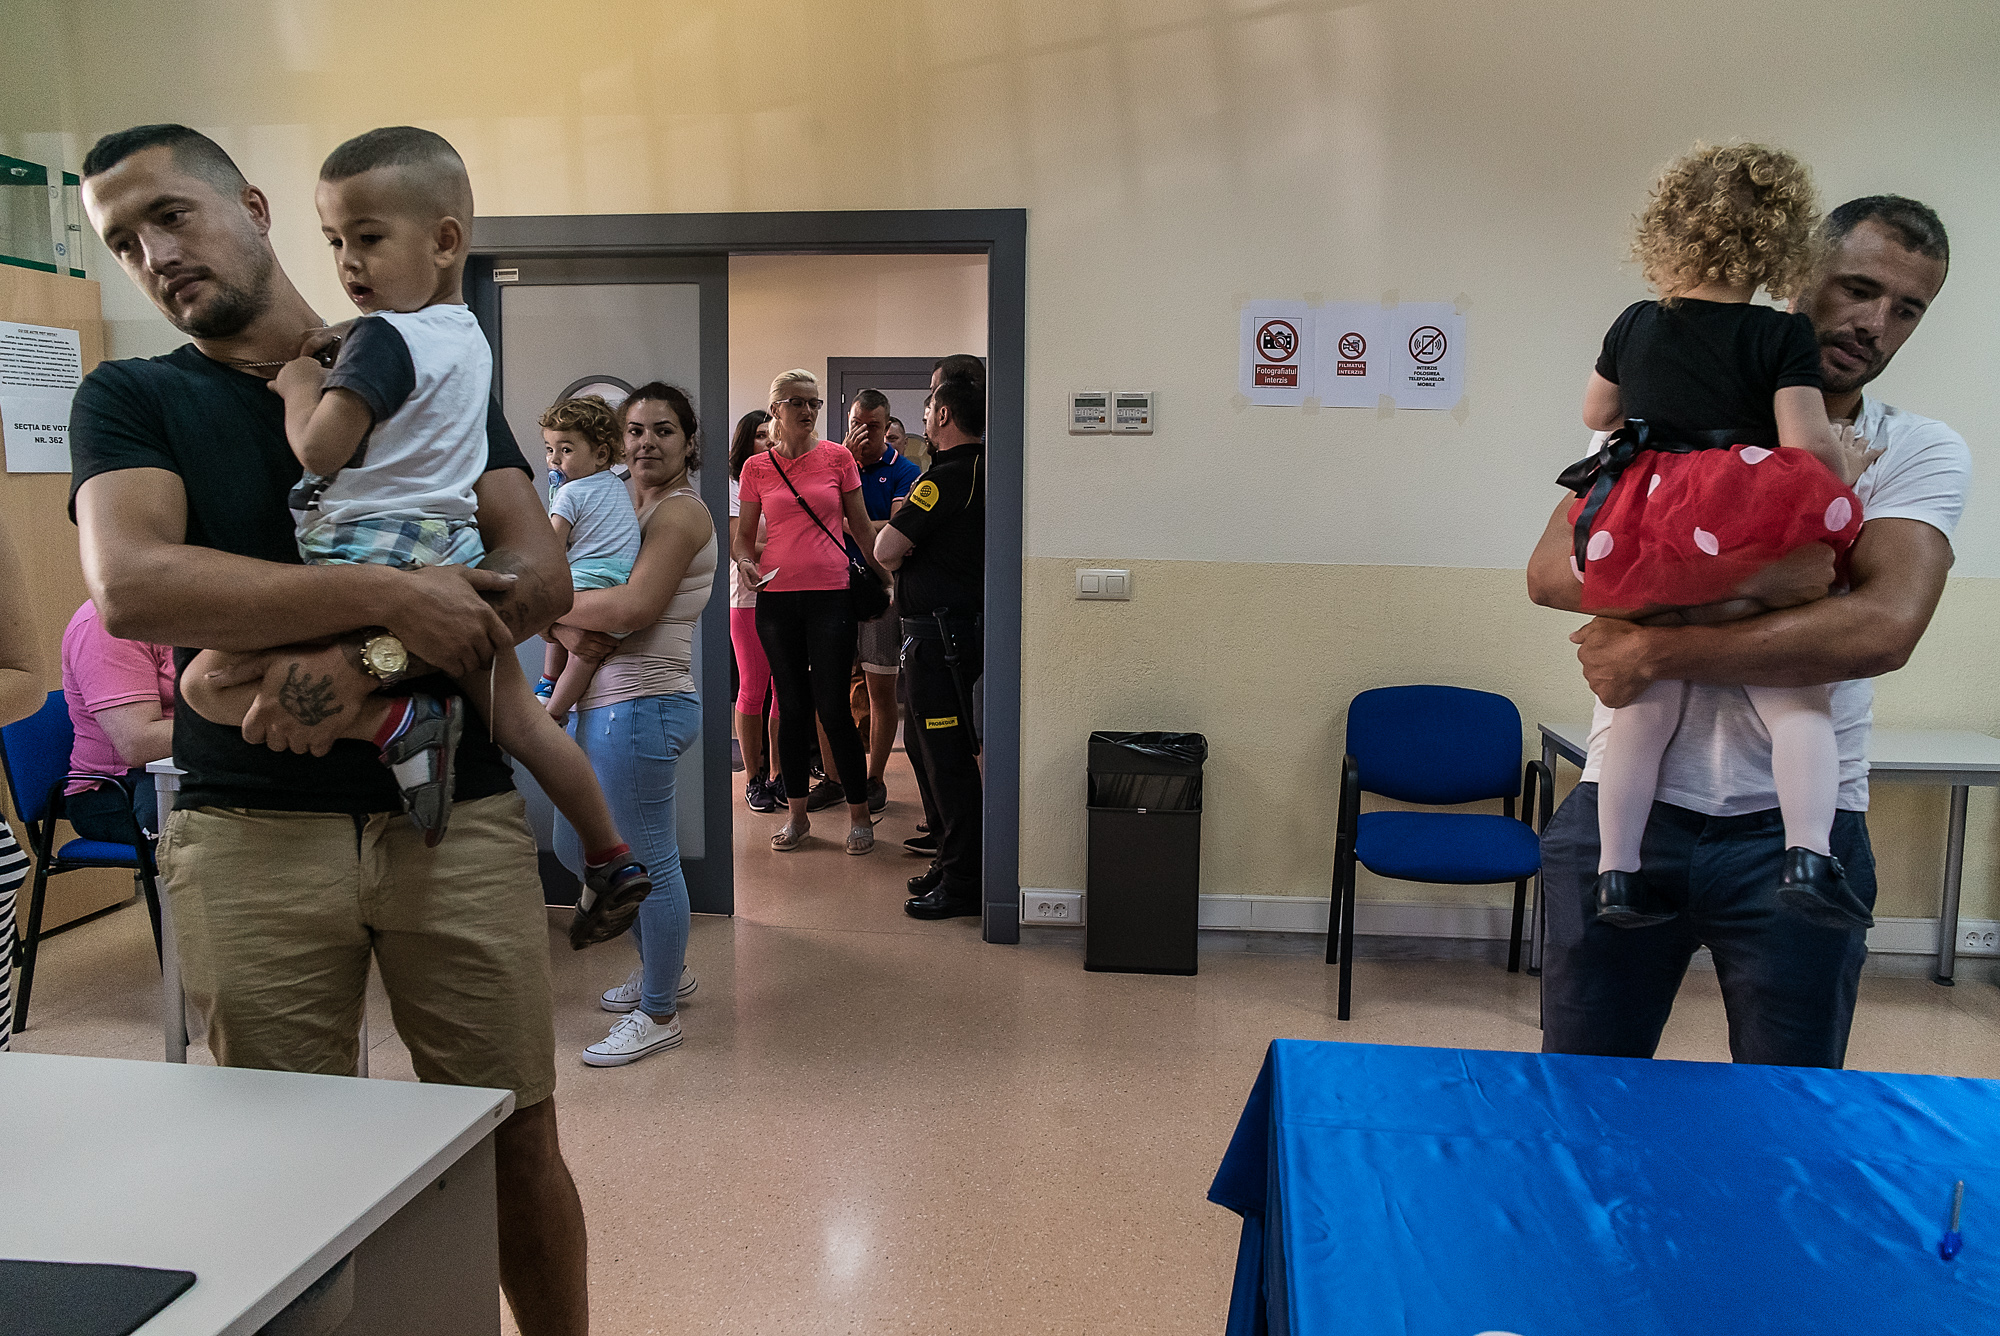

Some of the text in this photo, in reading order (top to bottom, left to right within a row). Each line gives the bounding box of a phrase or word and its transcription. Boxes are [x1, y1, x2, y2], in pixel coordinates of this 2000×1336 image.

[1256, 367, 1297, 376] Fotografiatul
[1264, 376, 1288, 384] interzis
[34, 436, 64, 444] NR. 362
